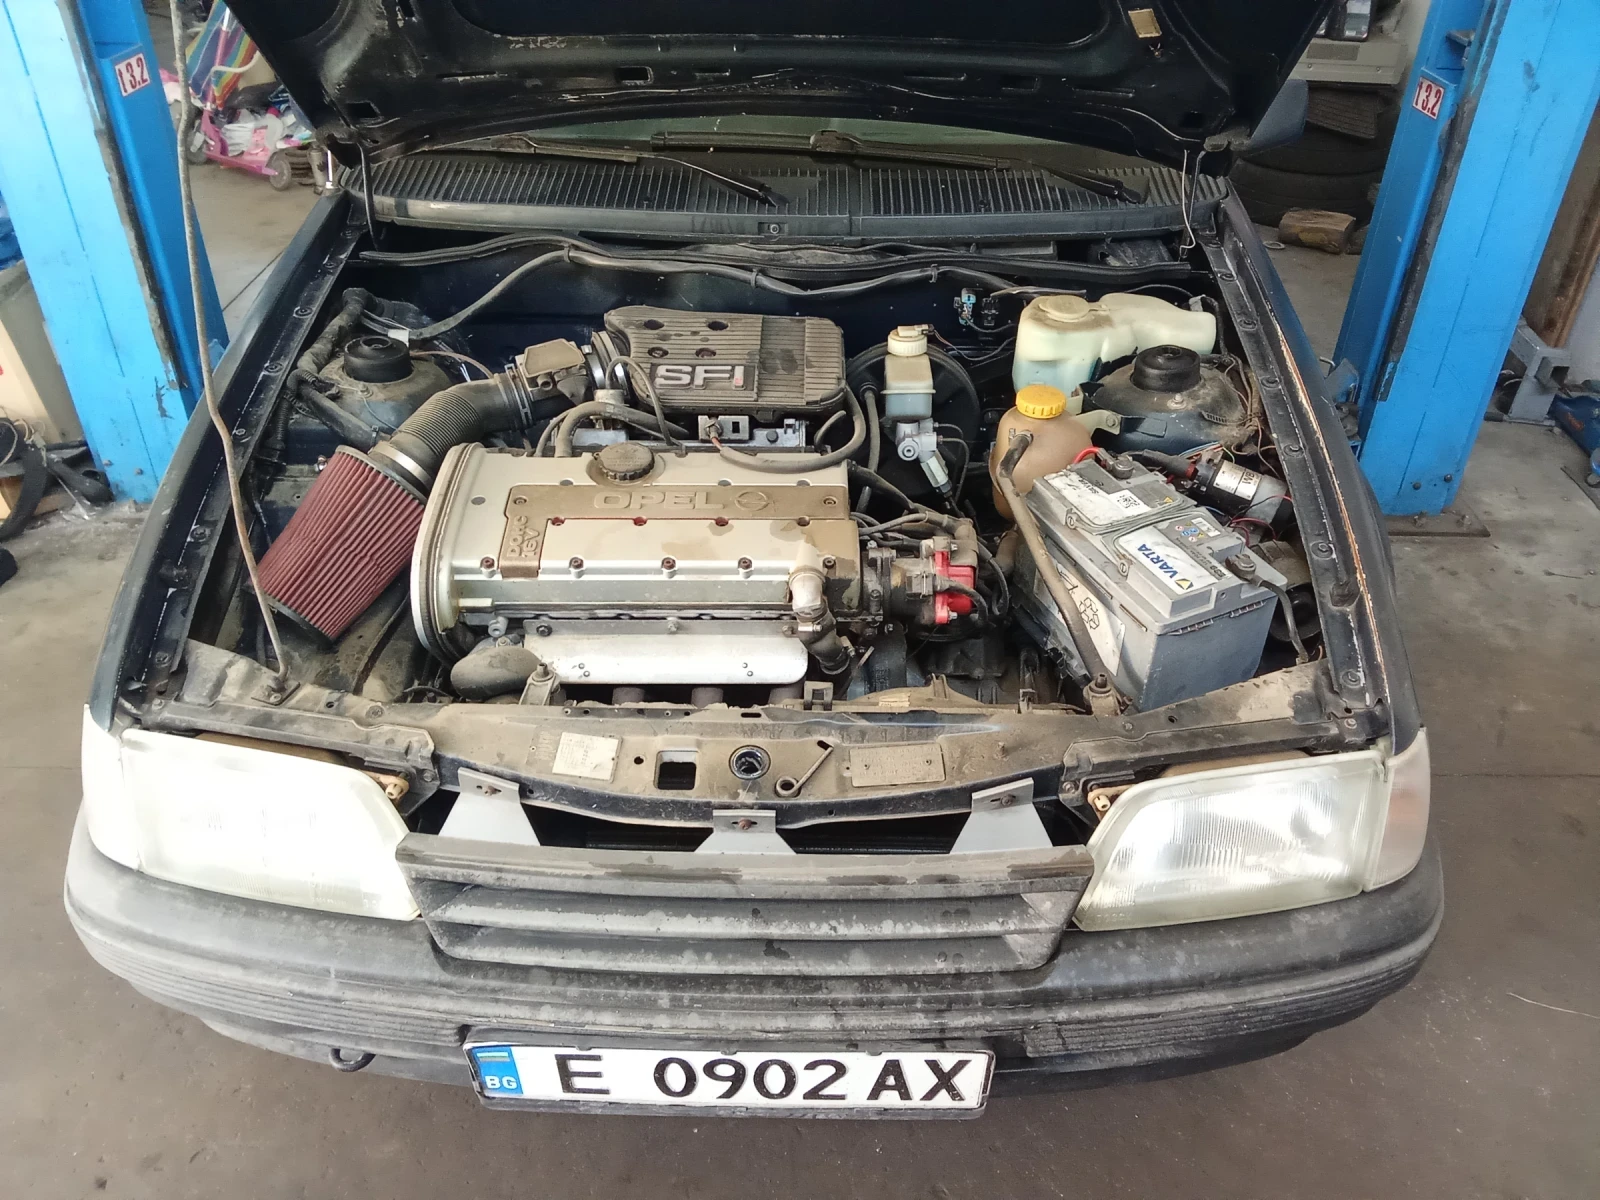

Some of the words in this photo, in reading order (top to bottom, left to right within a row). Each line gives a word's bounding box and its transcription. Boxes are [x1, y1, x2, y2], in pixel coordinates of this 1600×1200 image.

[654, 365, 745, 389] SFI
[593, 491, 725, 510] OPEL
[506, 515, 528, 558] DOHC
[522, 528, 540, 559] 16V
[1137, 543, 1179, 579] VARTA
[485, 1075, 518, 1091] BG
[553, 1053, 611, 1095] E
[652, 1056, 850, 1101] 0902
[865, 1058, 973, 1102] AX
